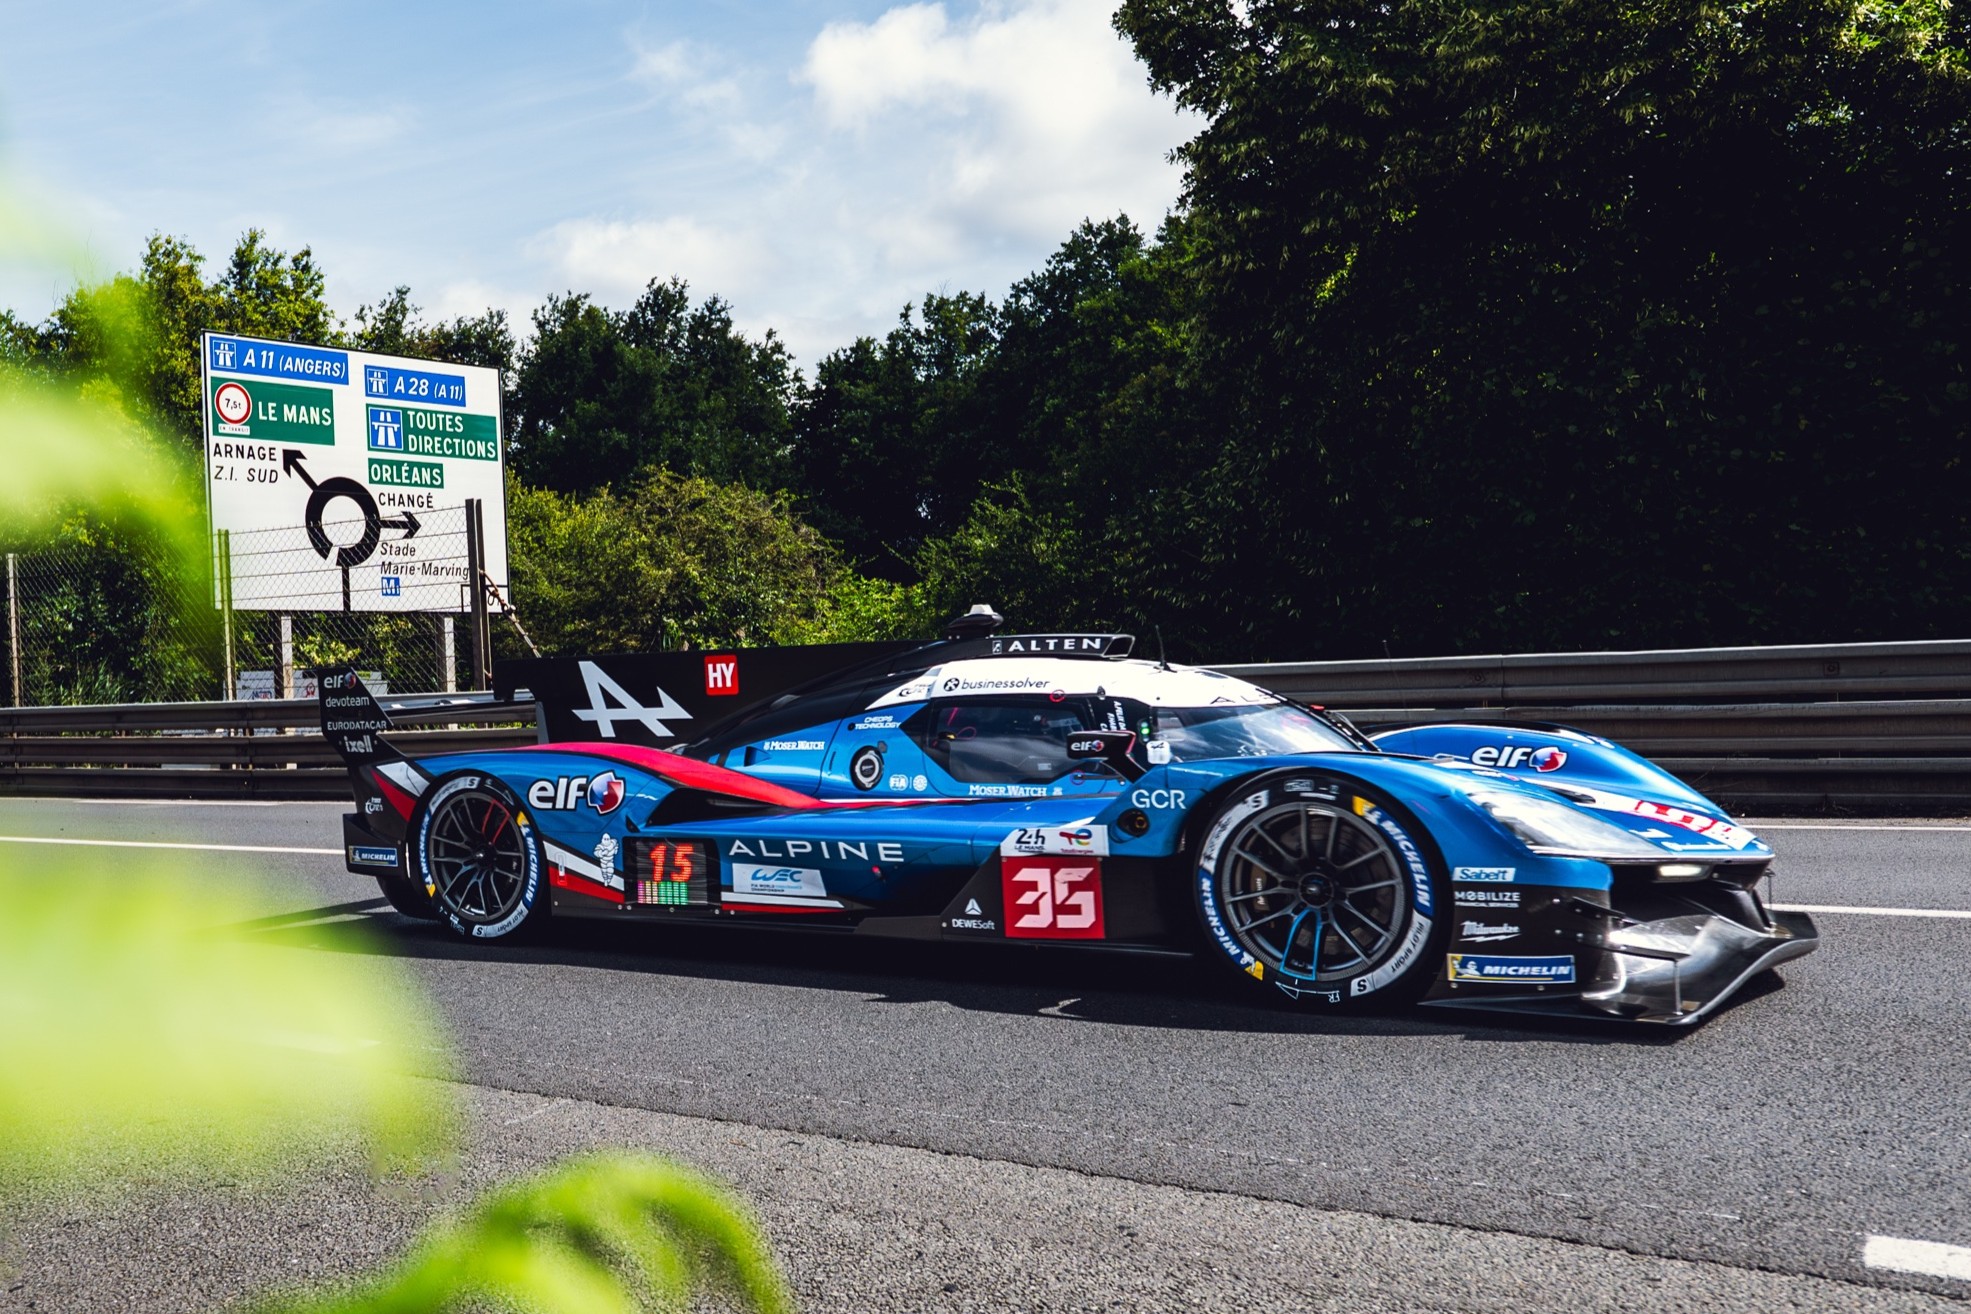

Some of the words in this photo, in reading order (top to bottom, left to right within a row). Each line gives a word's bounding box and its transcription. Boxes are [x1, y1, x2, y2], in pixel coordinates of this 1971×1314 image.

[243, 348, 256, 368] A
[260, 350, 275, 370] 11
[279, 354, 346, 379] (ANGERS)
[394, 376, 405, 394] A
[408, 377, 428, 396] 28
[433, 382, 448, 400] (A
[450, 384, 463, 402] 11)
[258, 400, 278, 422] LE
[283, 405, 332, 427] MANS
[407, 410, 464, 433] TOUTES
[213, 442, 277, 462] ARNAGE
[408, 434, 497, 459] DIRECTIONS
[214, 465, 238, 481] Z.I.
[246, 467, 279, 484] SUD
[371, 463, 442, 486] ORLÉANS
[378, 492, 434, 509] CHANGÉ
[380, 542, 416, 557] Stade
[380, 561, 470, 581] Marie-Marving
[1008, 638, 1101, 652] ALTEN
[323, 674, 344, 689] elf
[707, 662, 735, 689] HY
[961, 677, 1051, 691] businessolver
[325, 695, 370, 708] devoteam
[327, 720, 387, 731] EURODATACAR
[343, 735, 374, 753] ixell
[1070, 741, 1093, 751] elf
[1471, 746, 1533, 768] elf
[527, 776, 588, 810] elf
[1131, 789, 1187, 810] GCR
[361, 852, 396, 862] MICHELIN
[728, 839, 905, 863] ALPINE
[525, 837, 538, 903] MICHELIN
[650, 843, 695, 884] 15
[1380, 820, 1432, 908] MICHELIN
[1011, 867, 1097, 929] 35
[951, 917, 996, 931] DEWESoft
[1201, 878, 1241, 956] MICHELIN
[1412, 922, 1426, 948] PILOT
[1390, 945, 1414, 975] SPORT
[1482, 965, 1572, 976] MICHELIN
[1356, 978, 1368, 993] S
